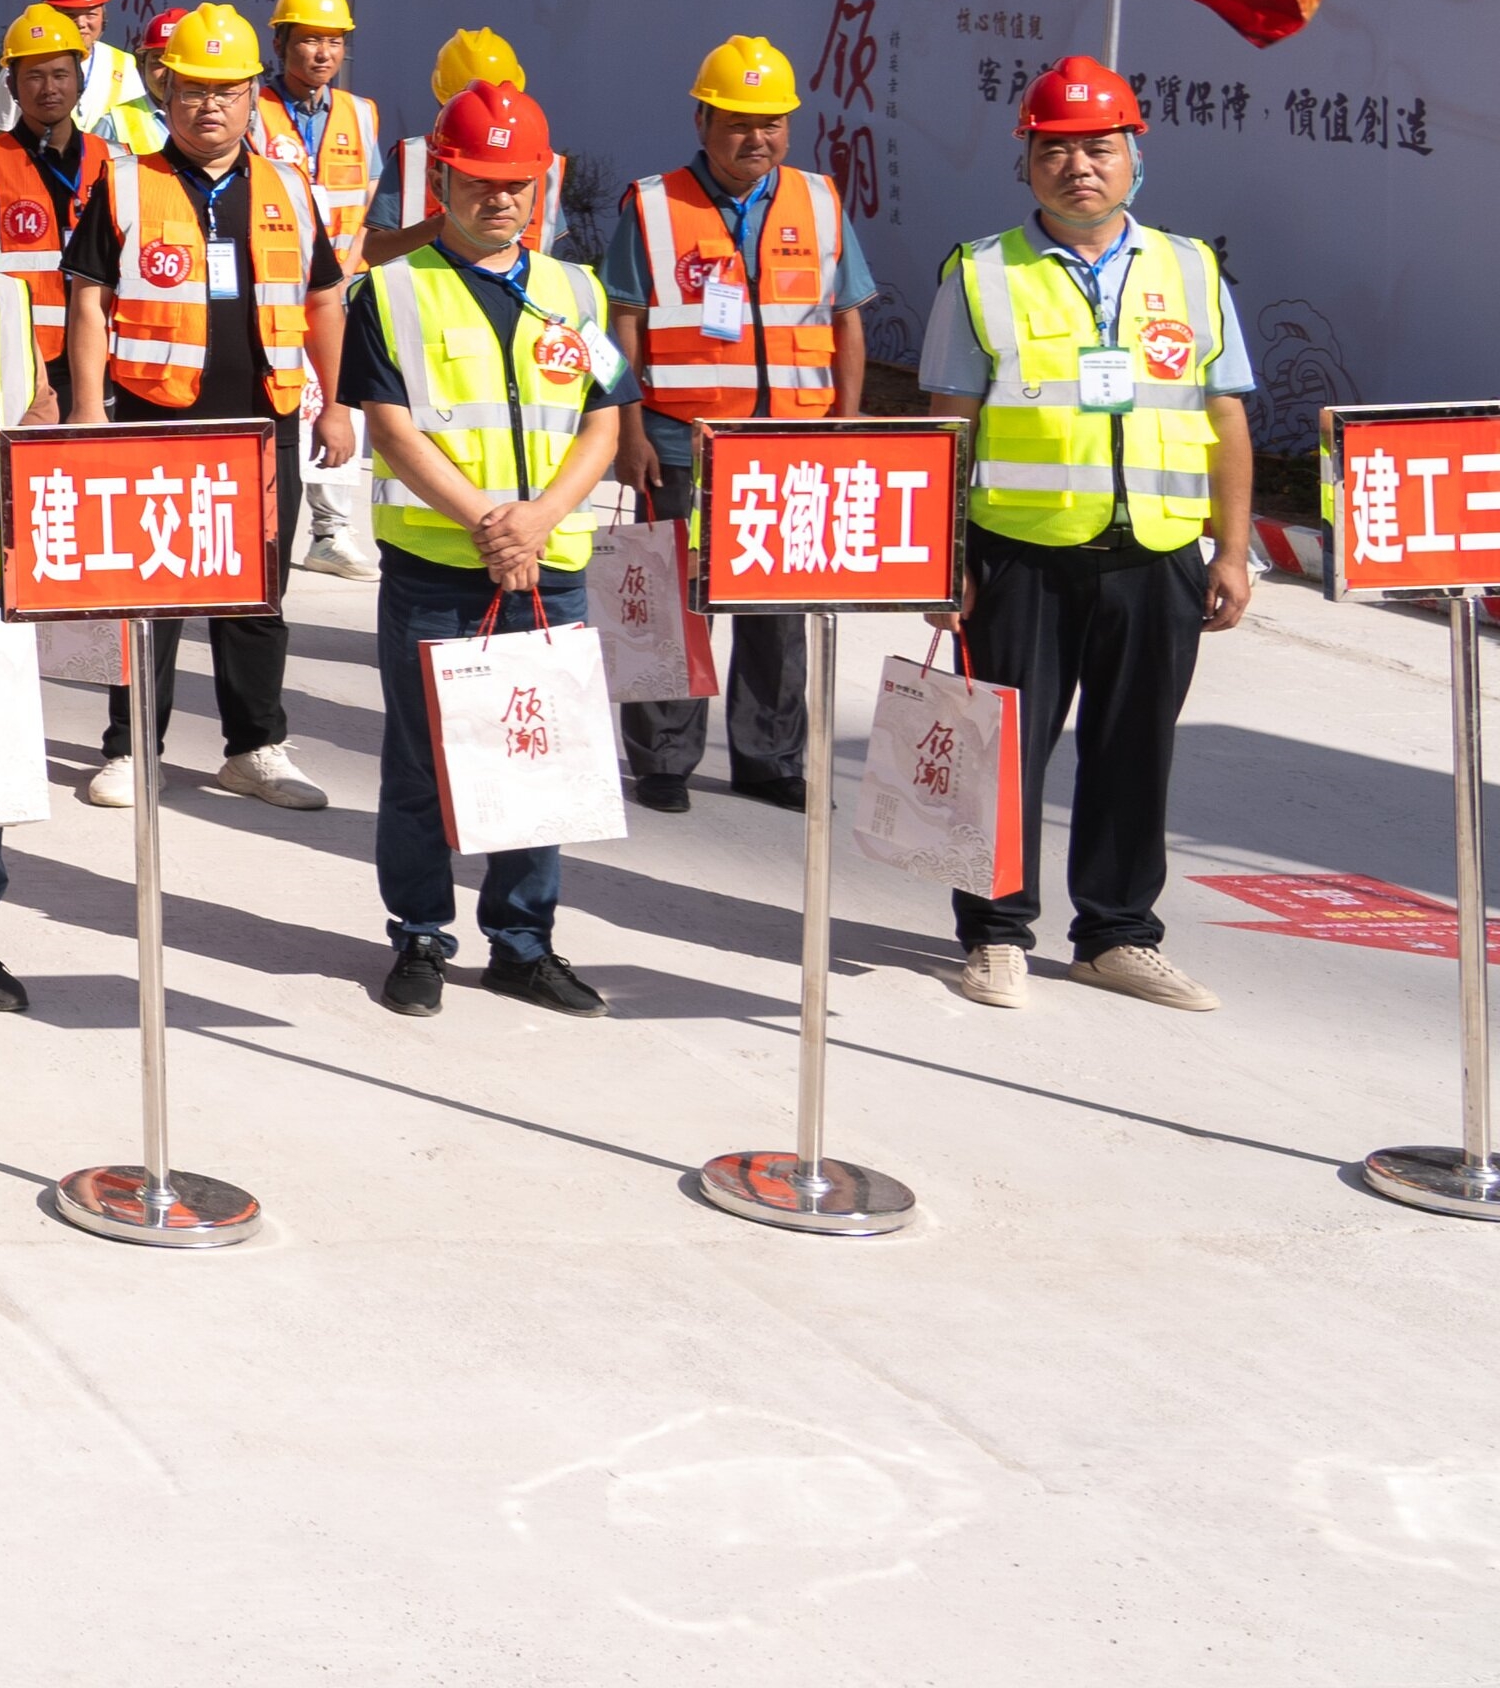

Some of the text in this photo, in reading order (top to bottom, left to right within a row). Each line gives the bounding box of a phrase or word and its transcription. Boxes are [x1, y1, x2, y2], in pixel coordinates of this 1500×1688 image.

[14, 212, 38, 234] 14
[150, 251, 180, 277] 36
[29, 462, 244, 583] 建工交航
[728, 459, 932, 578] 安徽建工
